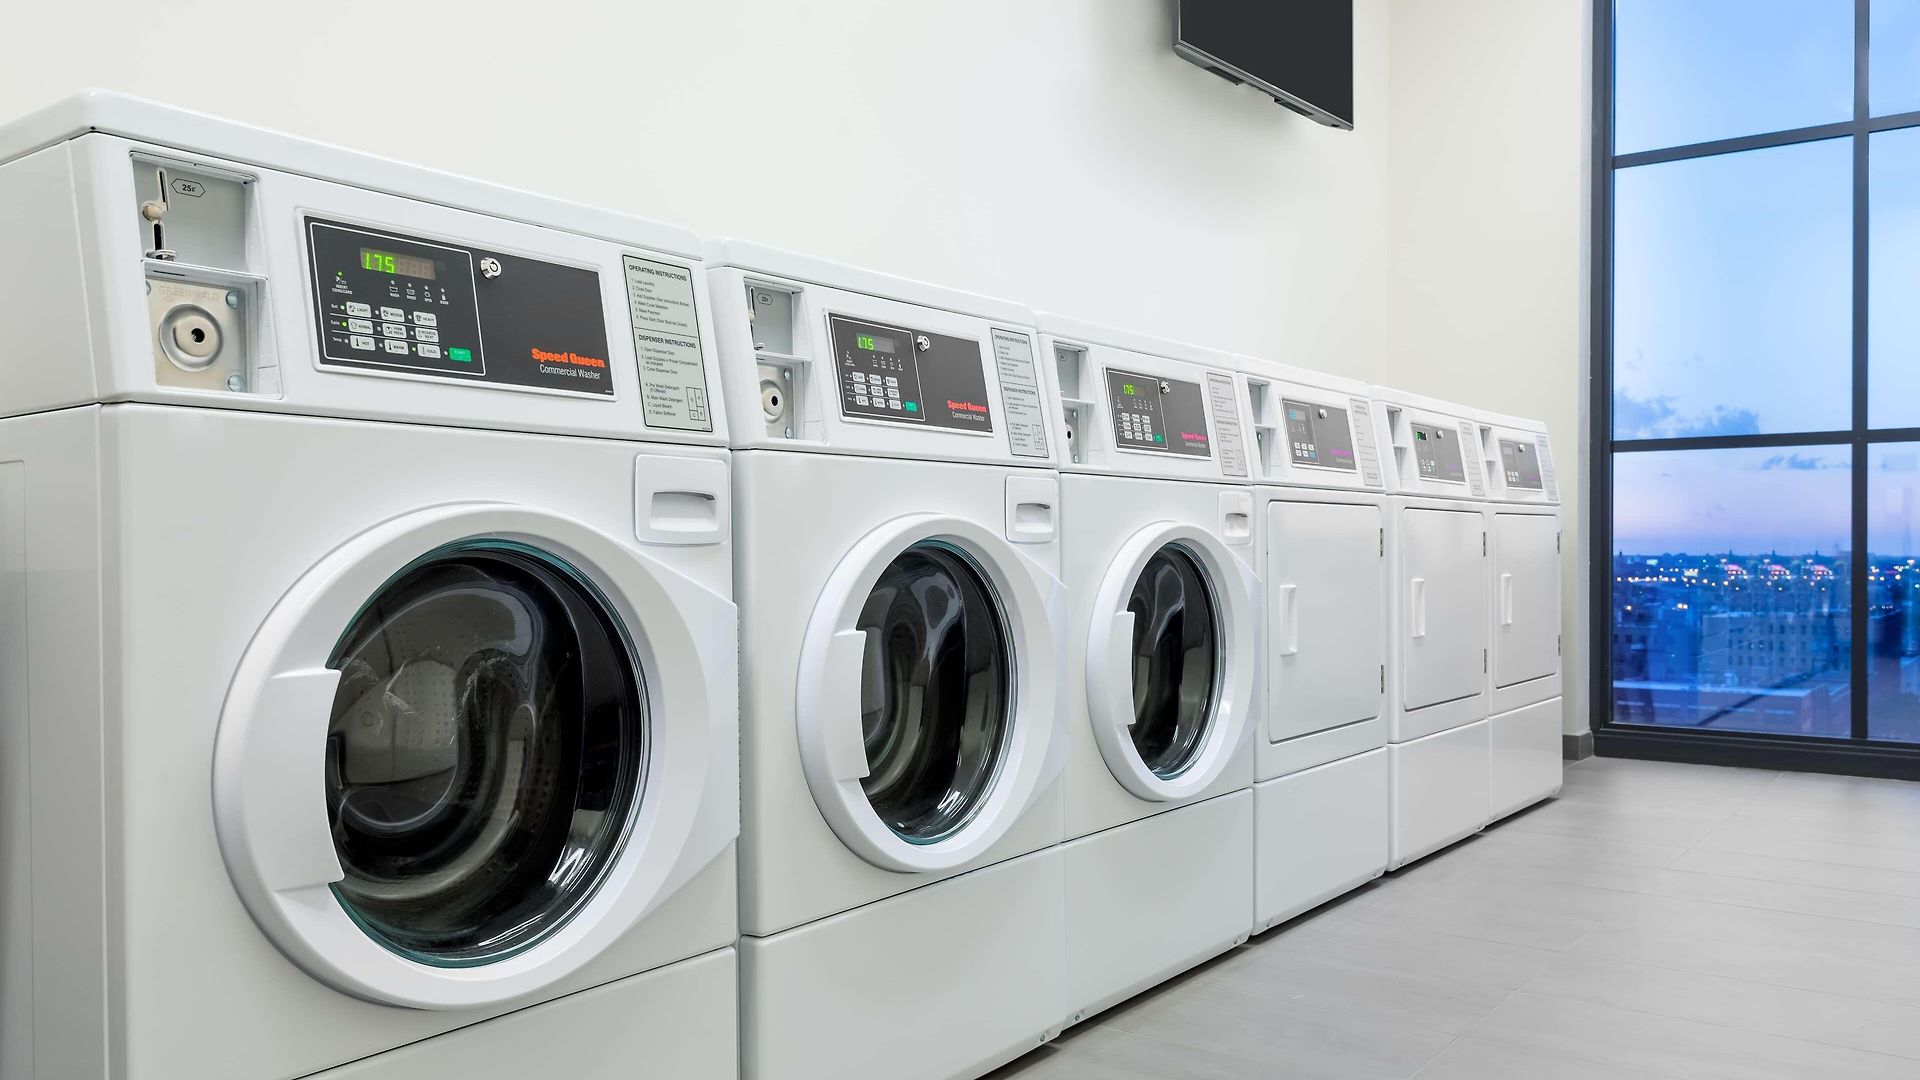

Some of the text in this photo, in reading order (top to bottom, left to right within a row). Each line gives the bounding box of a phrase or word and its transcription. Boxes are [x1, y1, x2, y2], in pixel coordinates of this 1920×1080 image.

[628, 265, 687, 281] OPERATING INSTRUCTIONS
[639, 335, 696, 349] DISPENSER INSTRUCTIONS
[531, 348, 605, 368] Speed Queen
[540, 364, 601, 380] Commercial Washer
[947, 400, 968, 410] Speed
